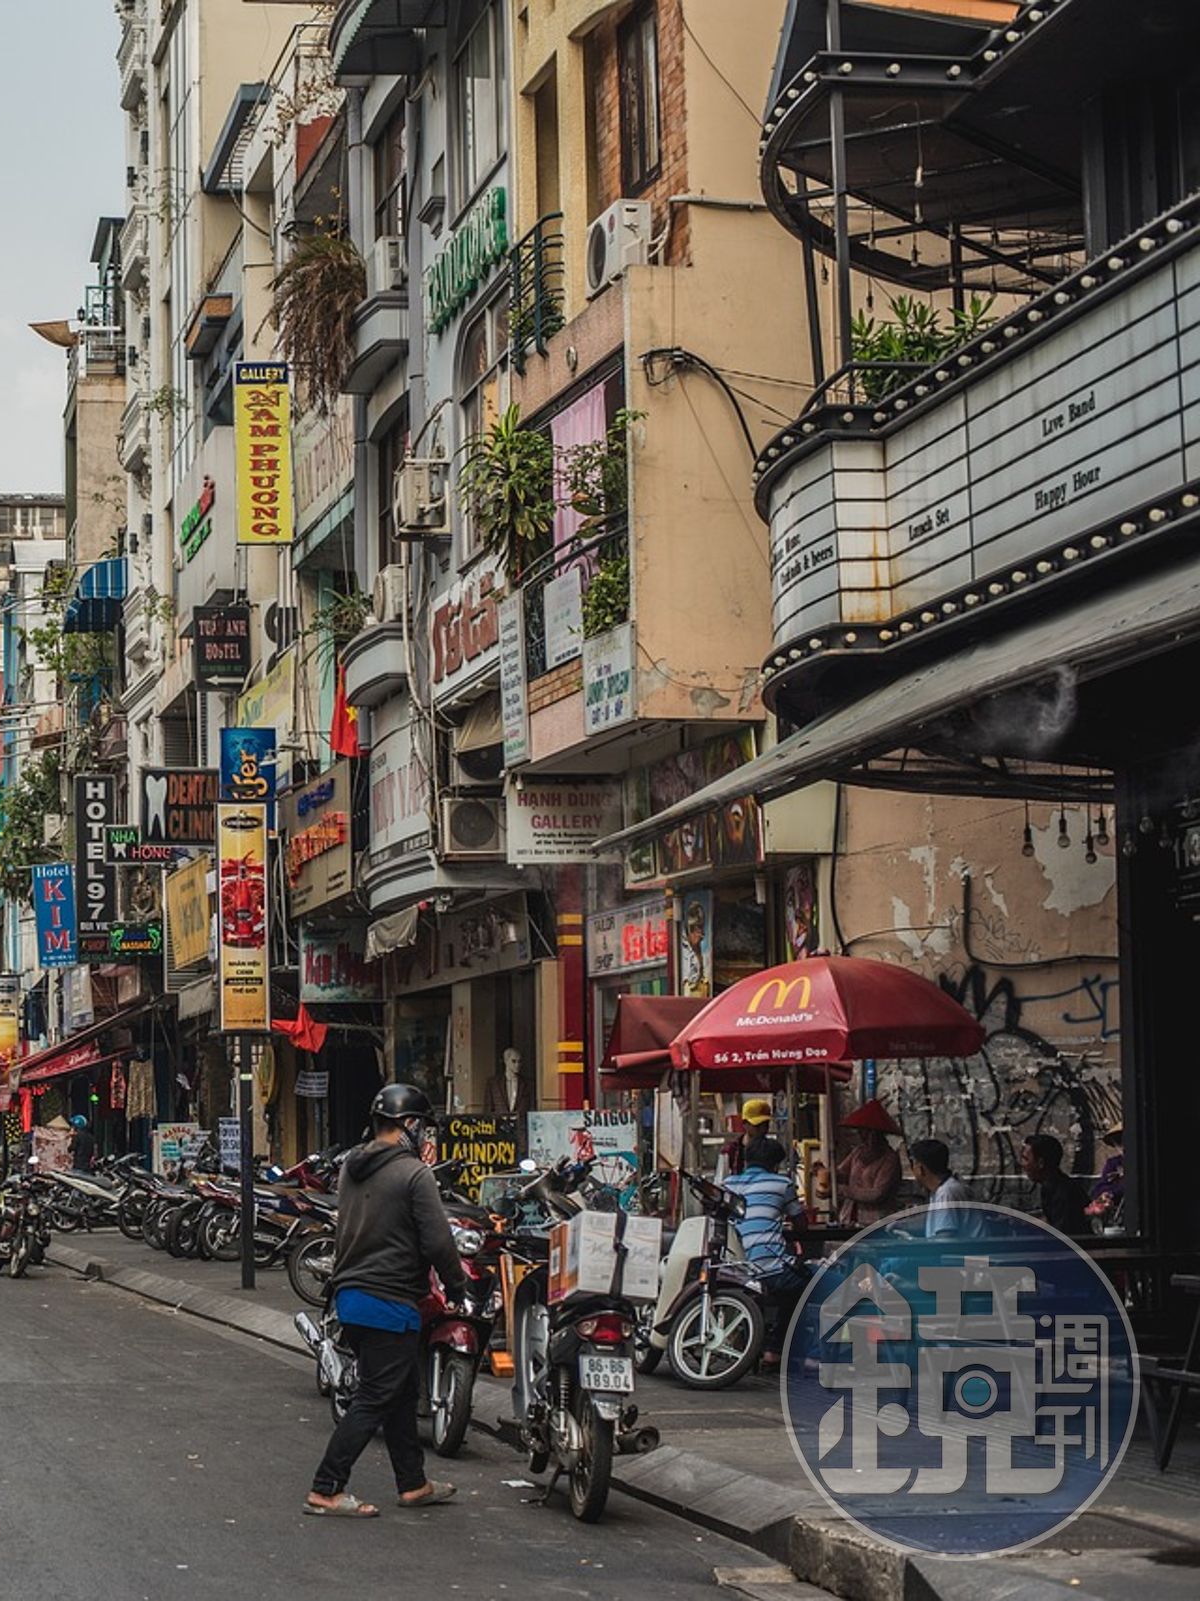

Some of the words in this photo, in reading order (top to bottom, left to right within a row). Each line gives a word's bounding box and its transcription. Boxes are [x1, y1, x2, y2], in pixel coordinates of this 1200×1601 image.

[240, 367, 285, 380] GALLERY
[1068, 391, 1096, 423] Band
[1034, 483, 1067, 510] Happy
[1072, 466, 1101, 492] Hour
[531, 815, 602, 829] GALLERY
[110, 831, 136, 842] NHA
[36, 866, 70, 878] Hotel
[43, 880, 71, 953] KIM
[736, 1012, 813, 1028] McDonald's
[450, 1119, 497, 1139] Capital
[442, 1141, 515, 1165] LAUNDRY
